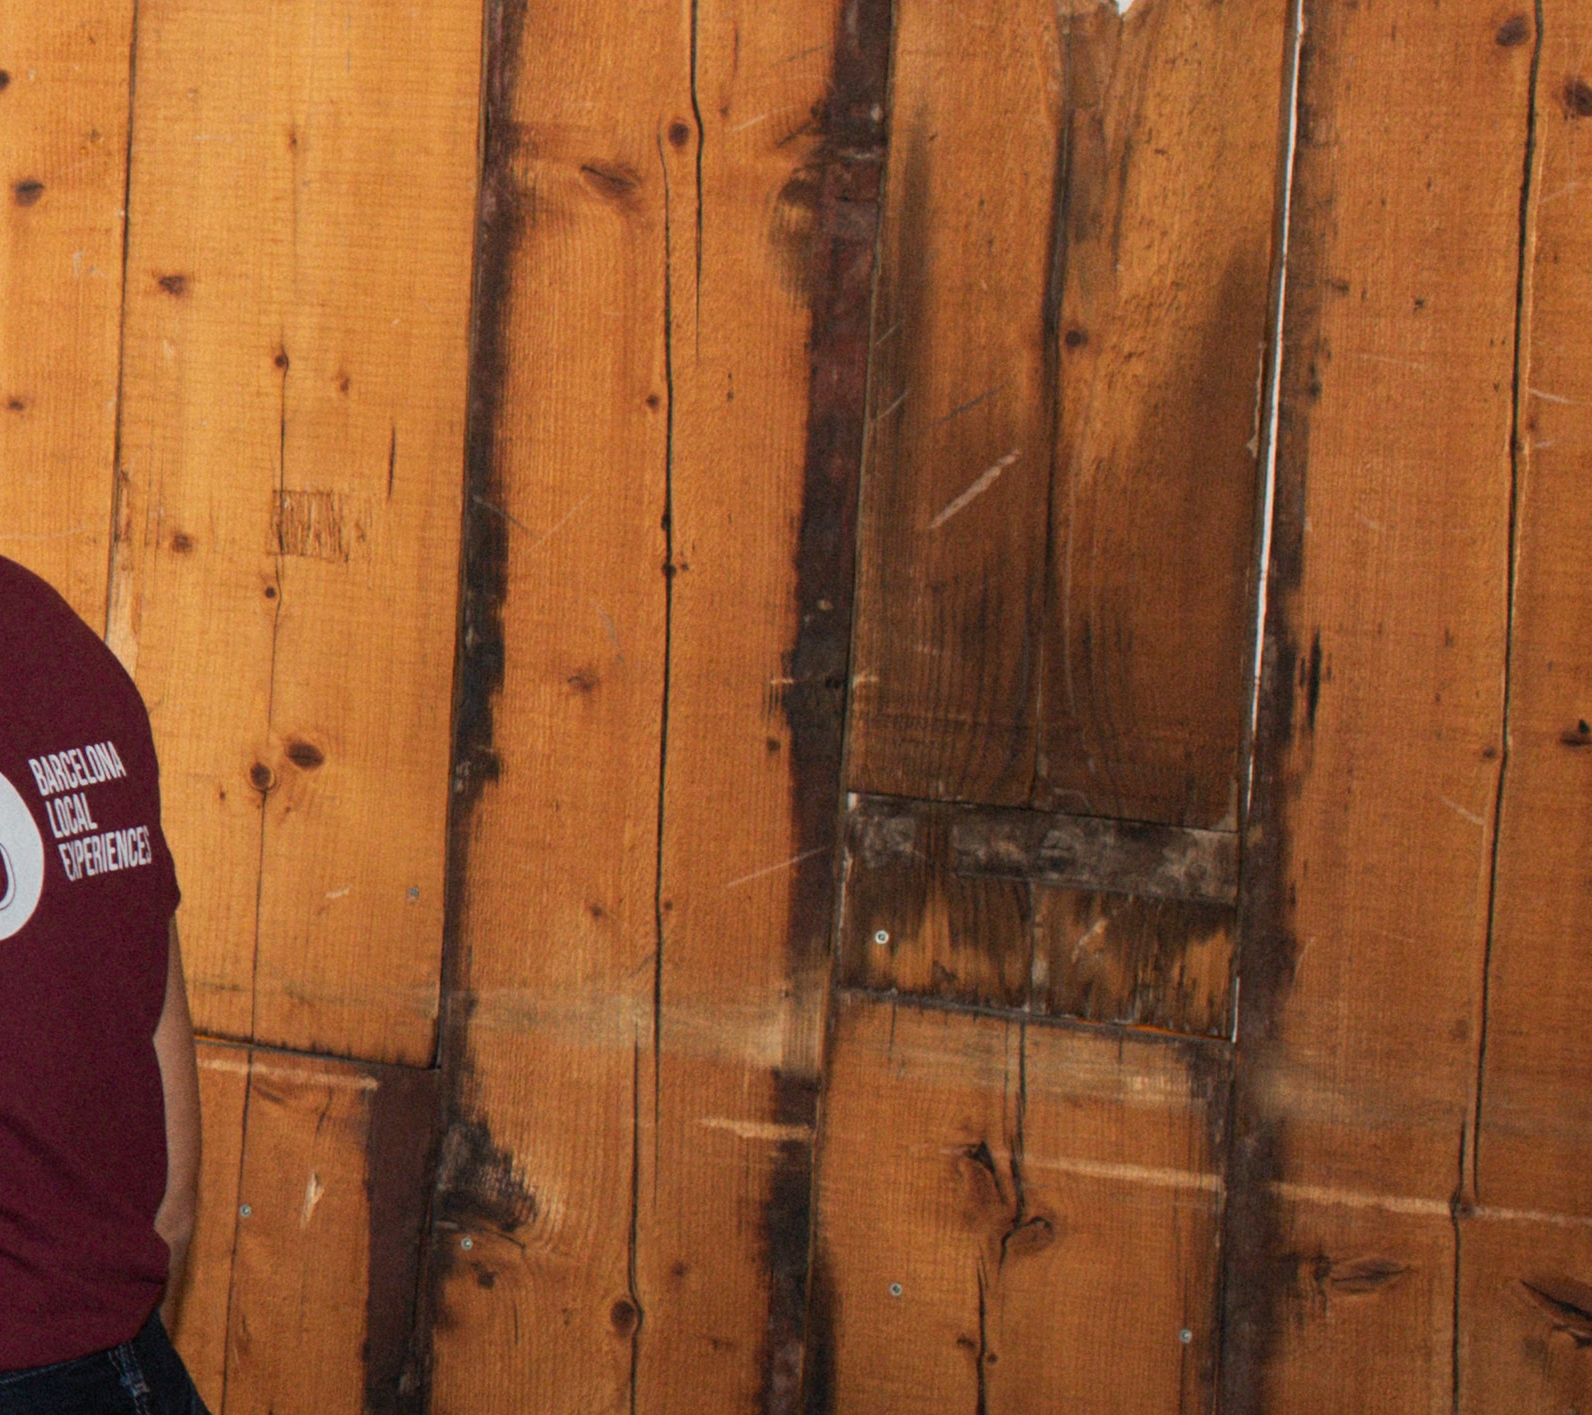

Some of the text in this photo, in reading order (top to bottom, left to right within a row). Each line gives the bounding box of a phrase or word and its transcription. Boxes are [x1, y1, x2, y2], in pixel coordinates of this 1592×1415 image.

[28, 740, 126, 796] BARCELONA
[45, 792, 98, 839] LOCAL
[57, 825, 152, 882] EXPERIENCES
